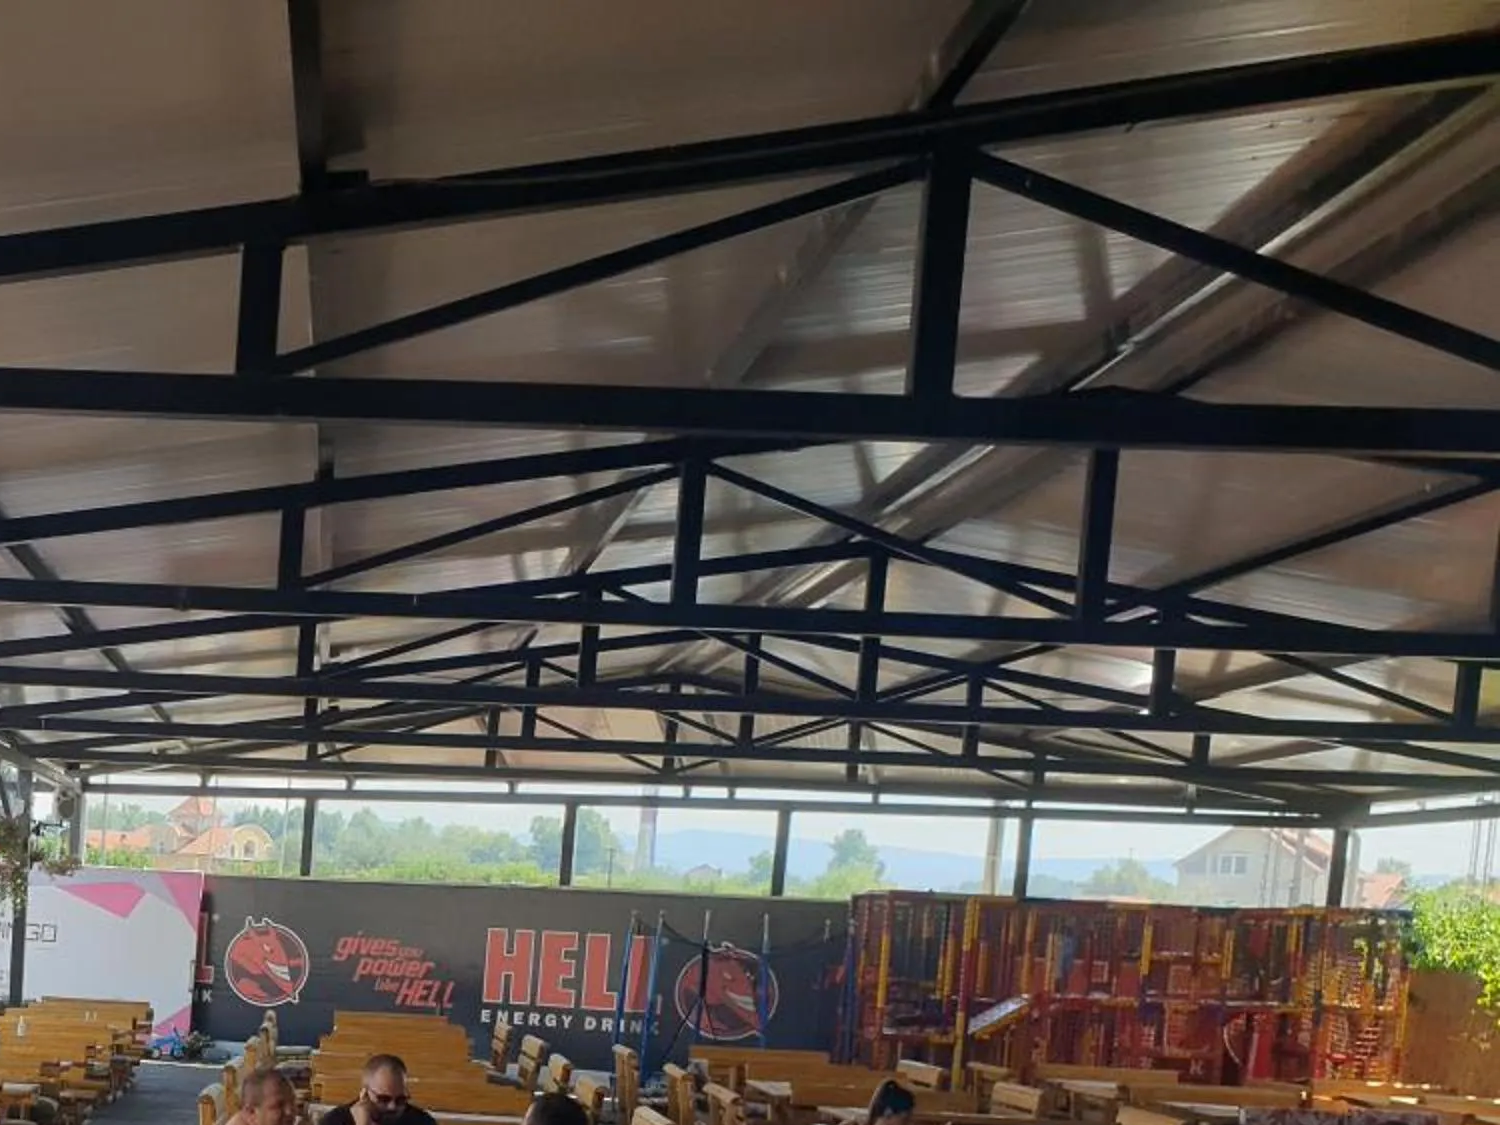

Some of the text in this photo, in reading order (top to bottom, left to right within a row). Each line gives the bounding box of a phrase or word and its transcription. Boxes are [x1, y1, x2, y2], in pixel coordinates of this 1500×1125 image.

[332, 931, 399, 961] gives
[353, 957, 436, 982] power
[482, 927, 662, 1015] HELL
[395, 978, 455, 1008] HELL
[480, 1009, 573, 1029] ENERGY
